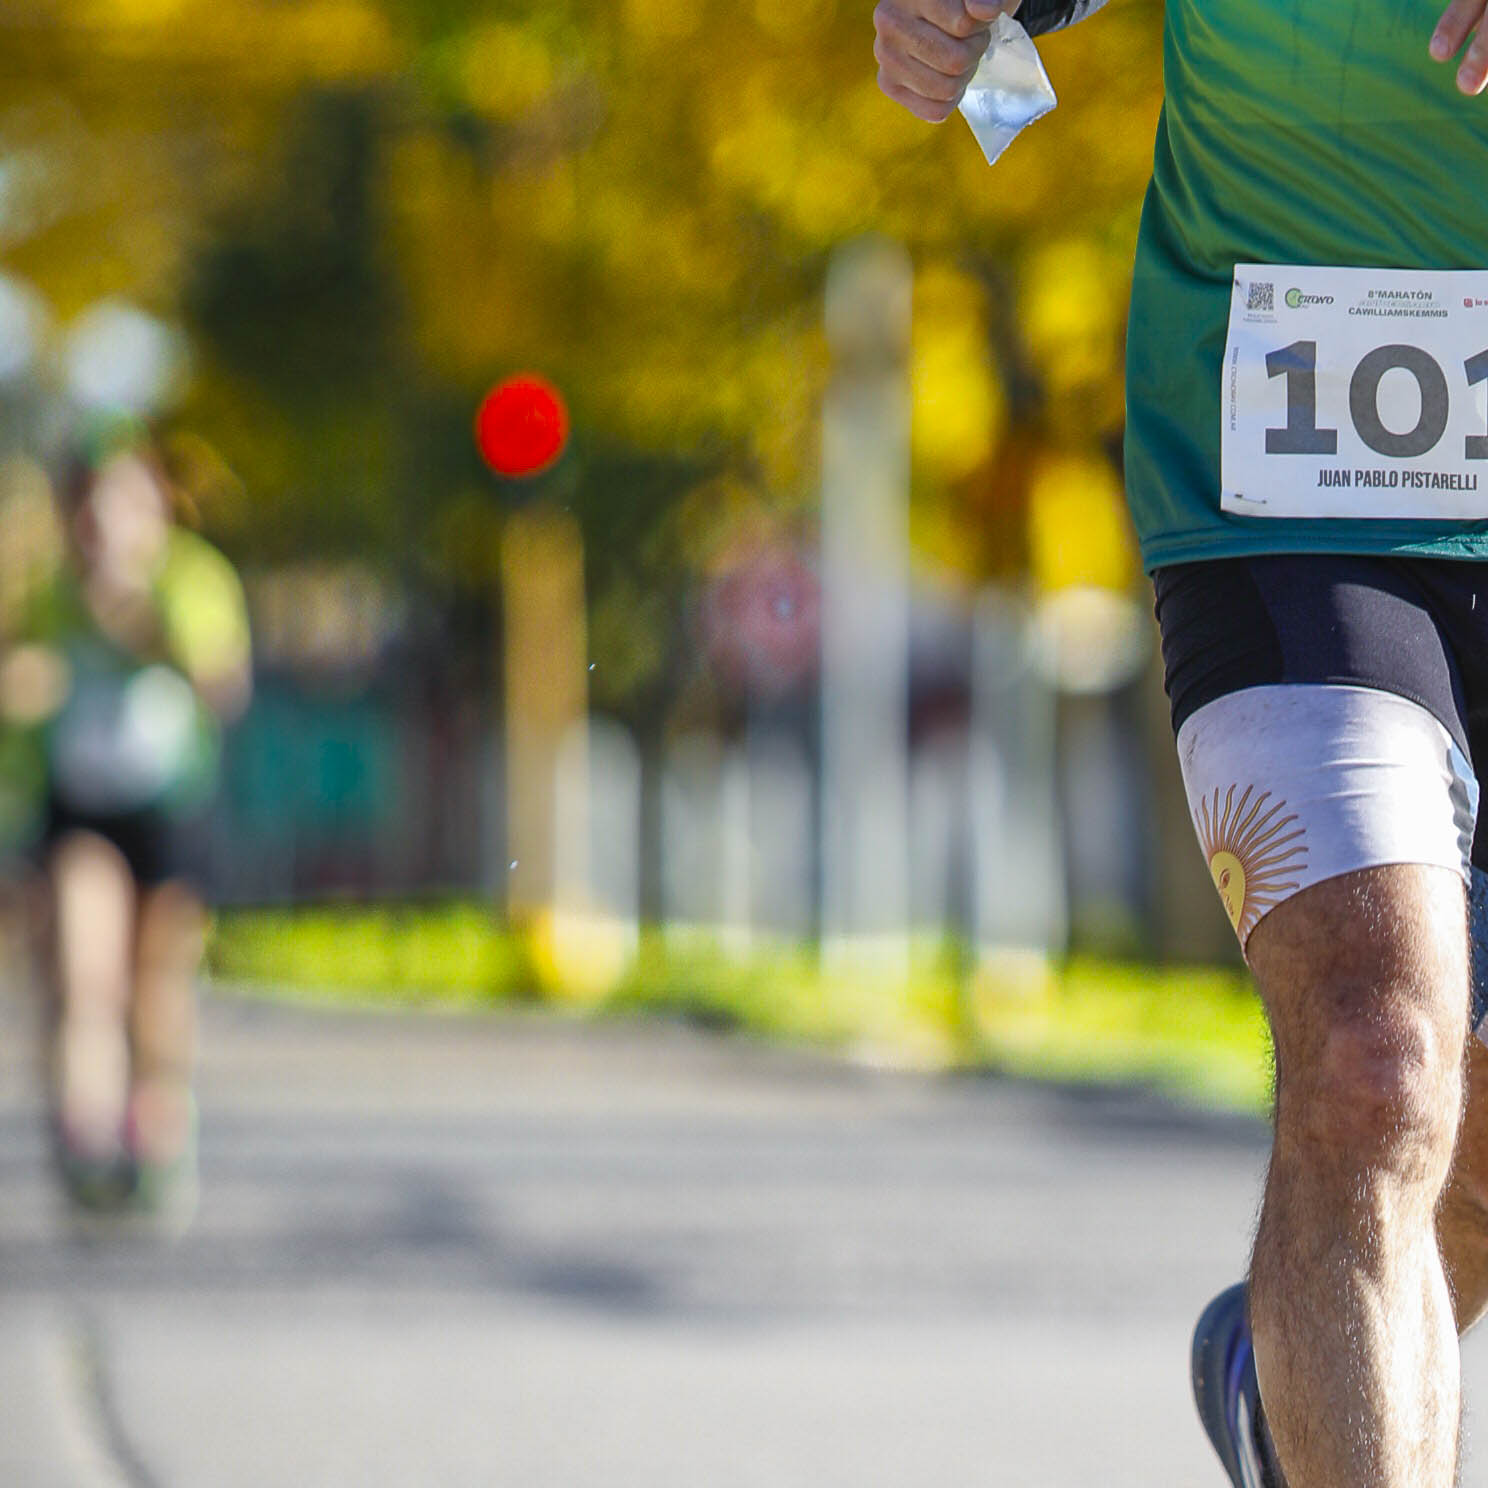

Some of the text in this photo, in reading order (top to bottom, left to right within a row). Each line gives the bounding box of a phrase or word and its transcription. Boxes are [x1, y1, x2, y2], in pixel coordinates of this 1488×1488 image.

[1317, 469, 1478, 491] JUAN PABLO PISTARELLI
